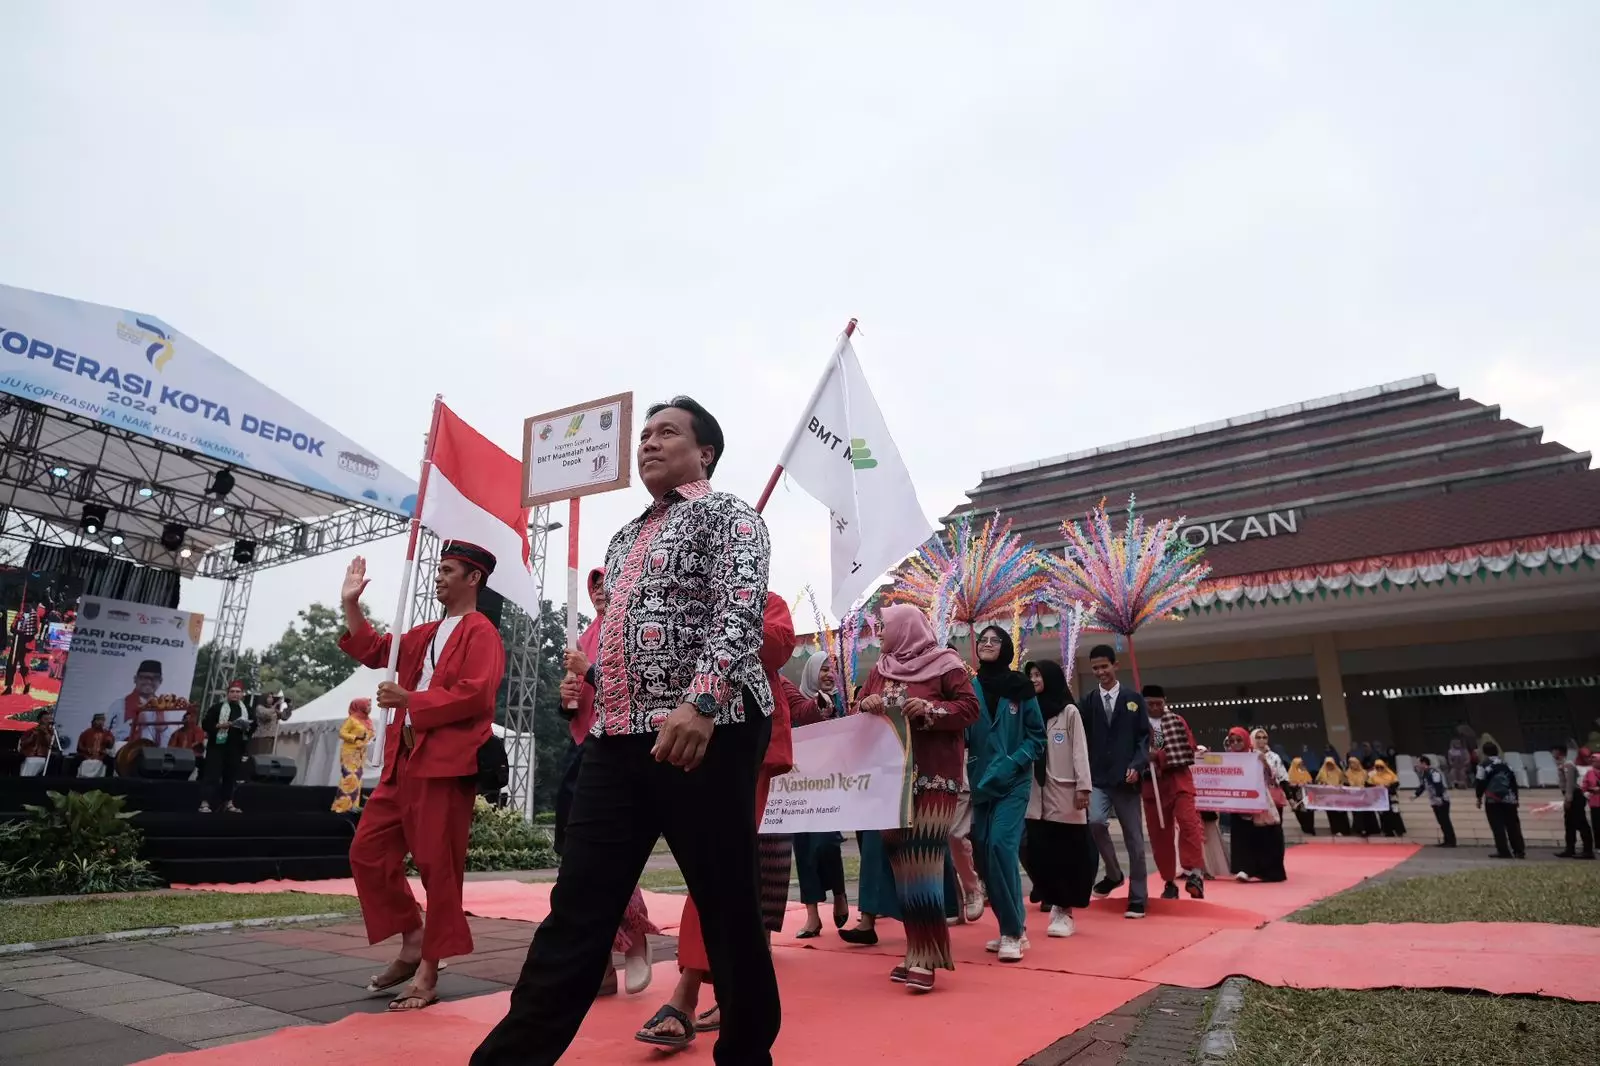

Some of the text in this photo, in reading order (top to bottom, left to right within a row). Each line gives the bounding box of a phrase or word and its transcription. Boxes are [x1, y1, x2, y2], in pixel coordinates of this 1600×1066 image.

[23, 382, 116, 419] KOPERASINYA
[122, 414, 152, 430] NAIK
[153, 425, 187, 441] KELAS
[107, 391, 158, 416] 2024
[160, 385, 231, 426] KOTA
[241, 413, 326, 458] DEPOK
[808, 416, 843, 450] BMT
[537, 441, 610, 464] BMT Muamalah Mandiri
[562, 456, 581, 467] Depok
[70, 637, 143, 652] OTA DEPOK
[109, 631, 184, 648] KOPERASI
[69, 646, 126, 657] AHUN 2024
[777, 772, 835, 793] Nasional
[838, 772, 872, 792] ke-77
[765, 805, 841, 816] BMT Muamalah Mandiri
[784, 798, 808, 807] Syariah
